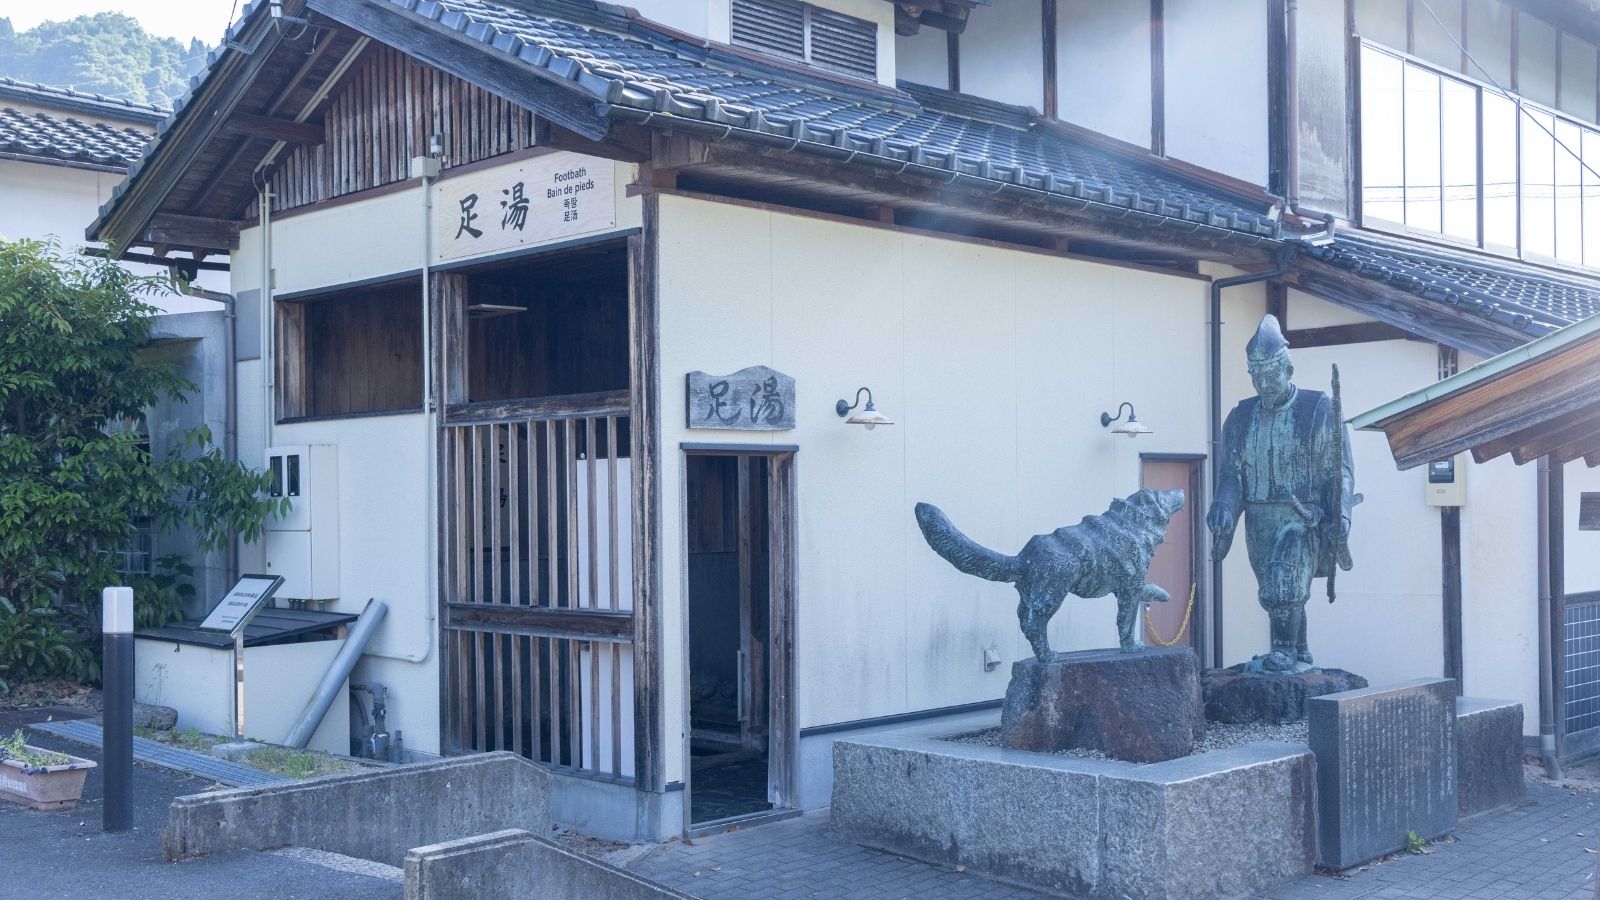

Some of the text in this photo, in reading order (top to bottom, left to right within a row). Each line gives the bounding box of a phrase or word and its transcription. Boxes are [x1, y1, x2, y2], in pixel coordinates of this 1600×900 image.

[554, 166, 586, 183] Footbath
[547, 179, 594, 198] Bain de pieds
[454, 181, 530, 240] 足湯
[563, 197, 578, 210] 족탕
[704, 375, 785, 426] 足湯
